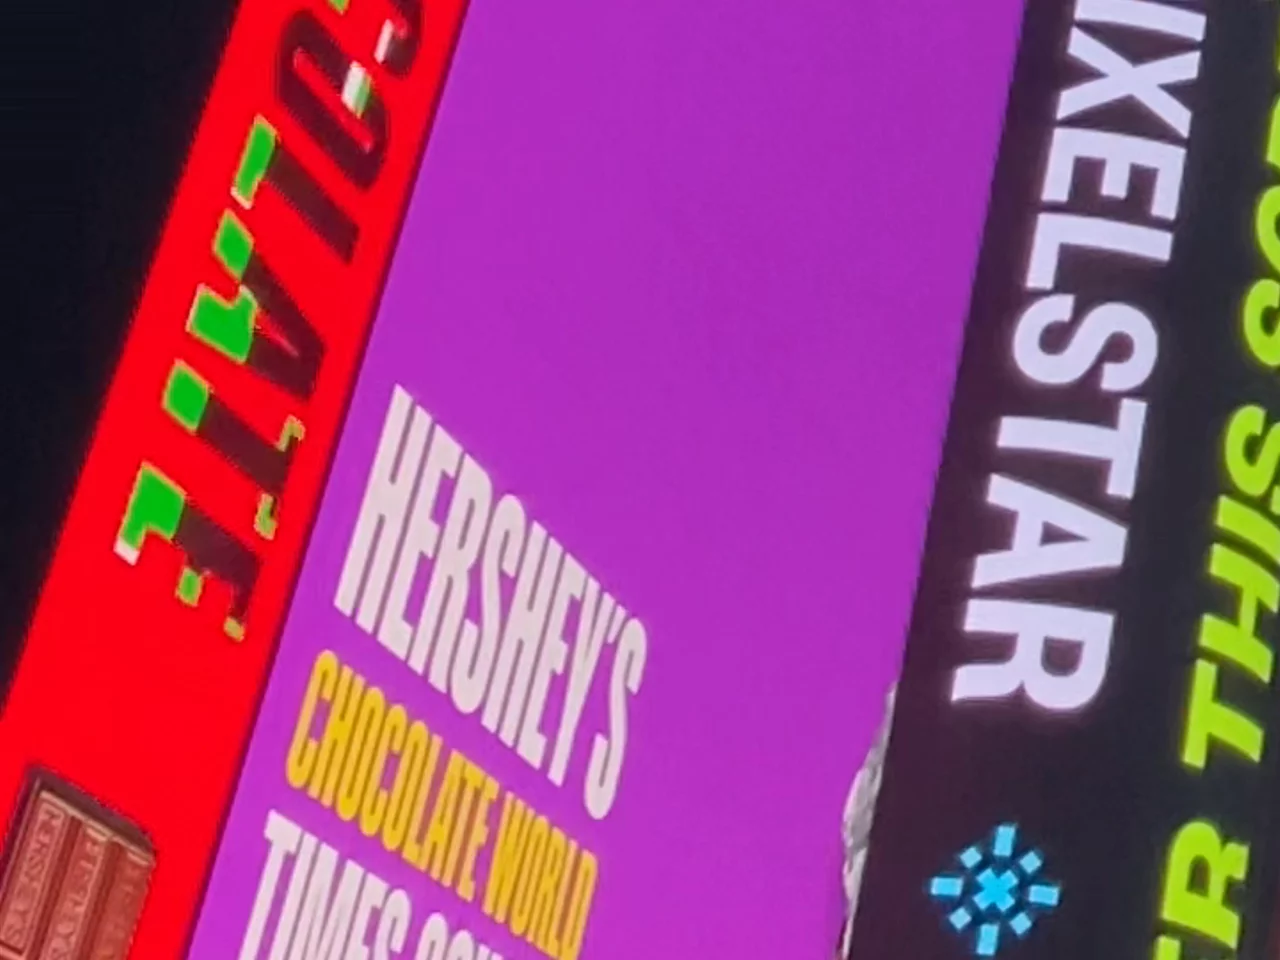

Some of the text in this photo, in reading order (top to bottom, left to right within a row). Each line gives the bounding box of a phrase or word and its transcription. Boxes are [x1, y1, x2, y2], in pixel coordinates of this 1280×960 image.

[333, 383, 648, 820] HERSHEY'S
[285, 649, 500, 902] CHOCOLATE
[482, 791, 599, 960] WORLD
